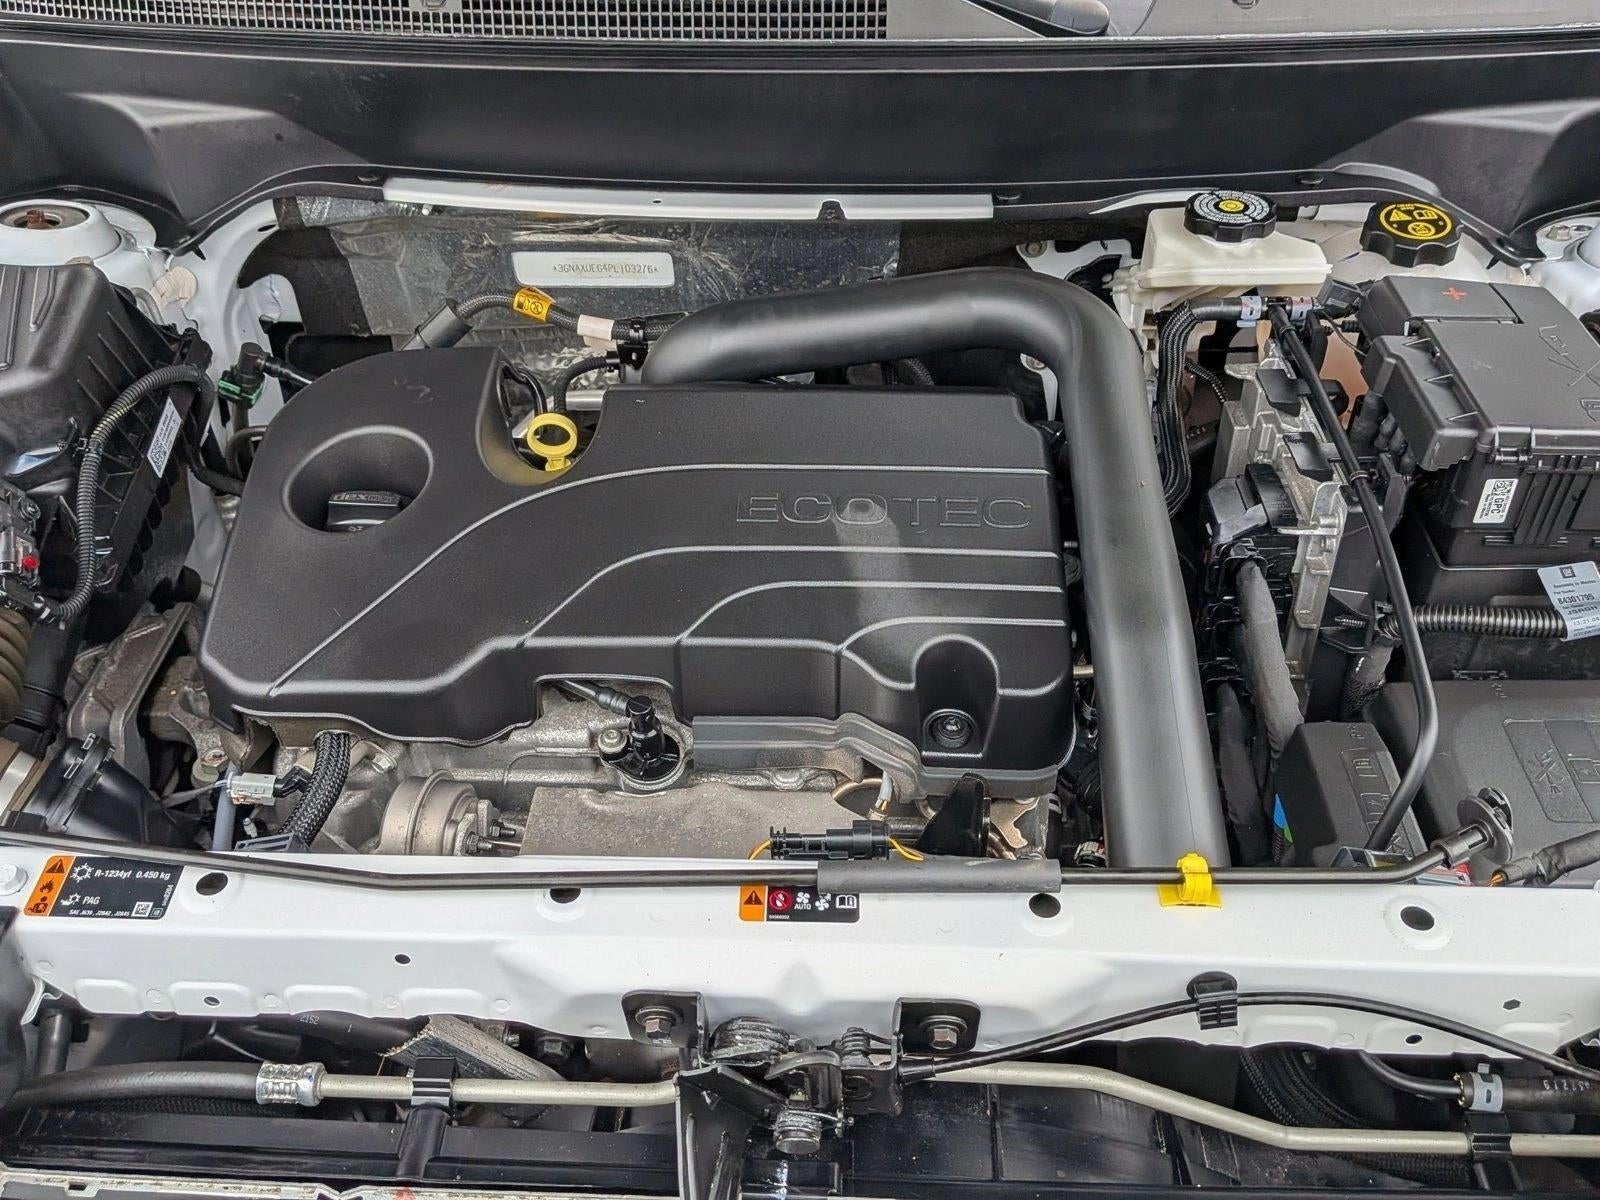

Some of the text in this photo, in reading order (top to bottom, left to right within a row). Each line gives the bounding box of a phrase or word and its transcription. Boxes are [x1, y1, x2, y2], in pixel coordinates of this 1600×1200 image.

[736, 493, 1032, 529] ECOTEC
[1490, 497, 1505, 514] GPC
[1557, 593, 1595, 605] 84301795
[94, 869, 171, 880] R-1234yf 0.450 kg
[82, 896, 100, 905] PAG
